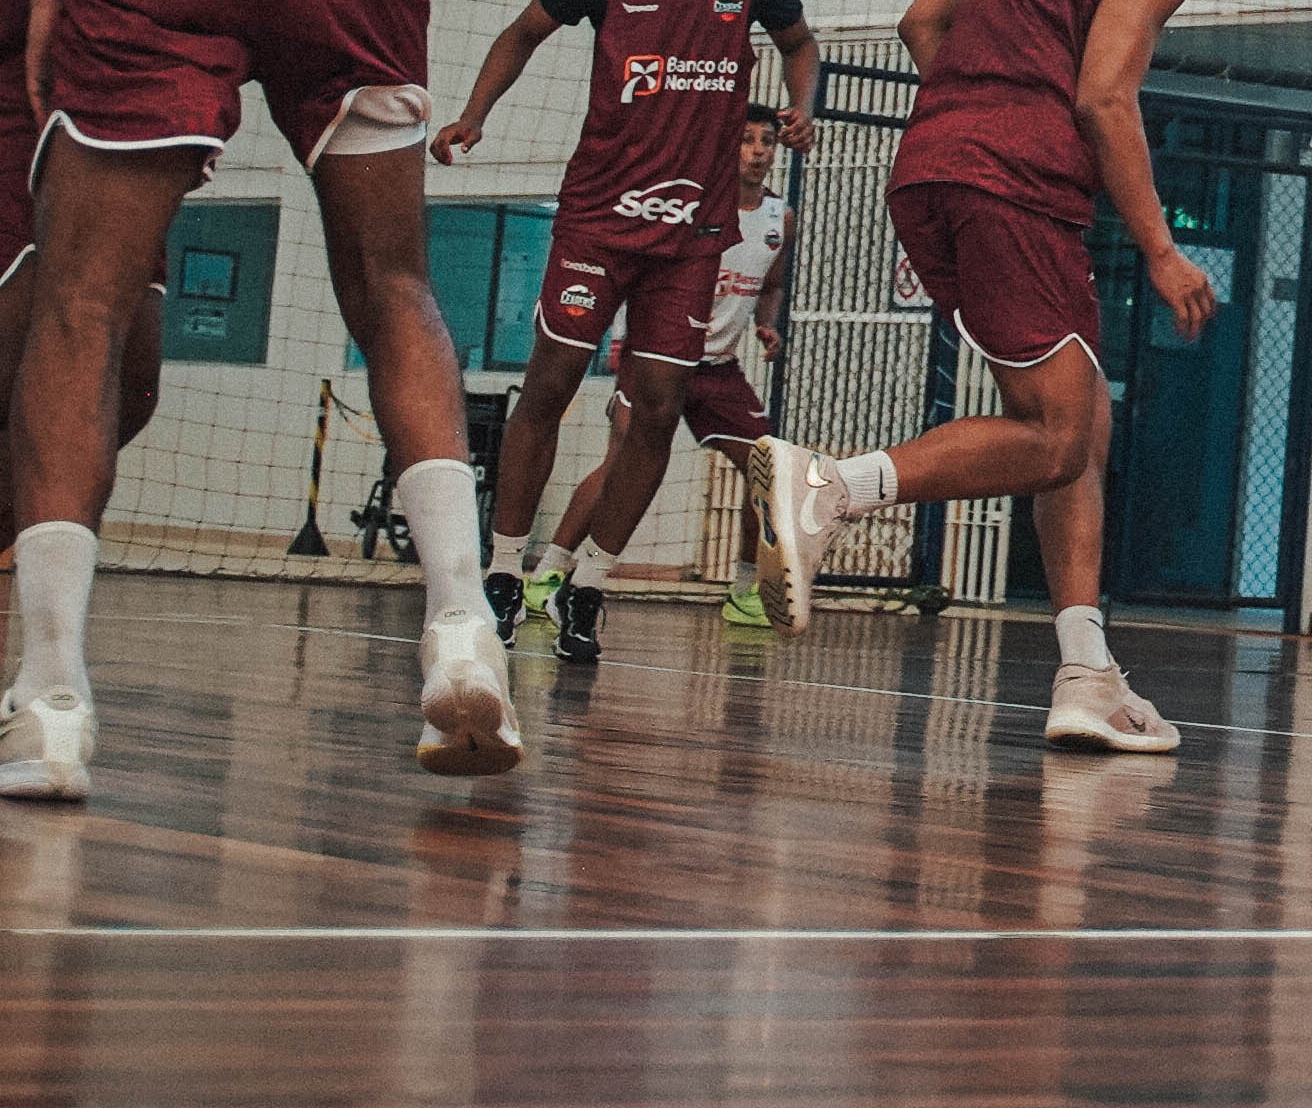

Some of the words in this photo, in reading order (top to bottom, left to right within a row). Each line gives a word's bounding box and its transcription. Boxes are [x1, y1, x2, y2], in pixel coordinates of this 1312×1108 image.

[666, 55, 719, 74] Banco
[717, 57, 739, 74] do
[664, 74, 736, 92] Nordeste
[612, 178, 705, 225] Sesc
